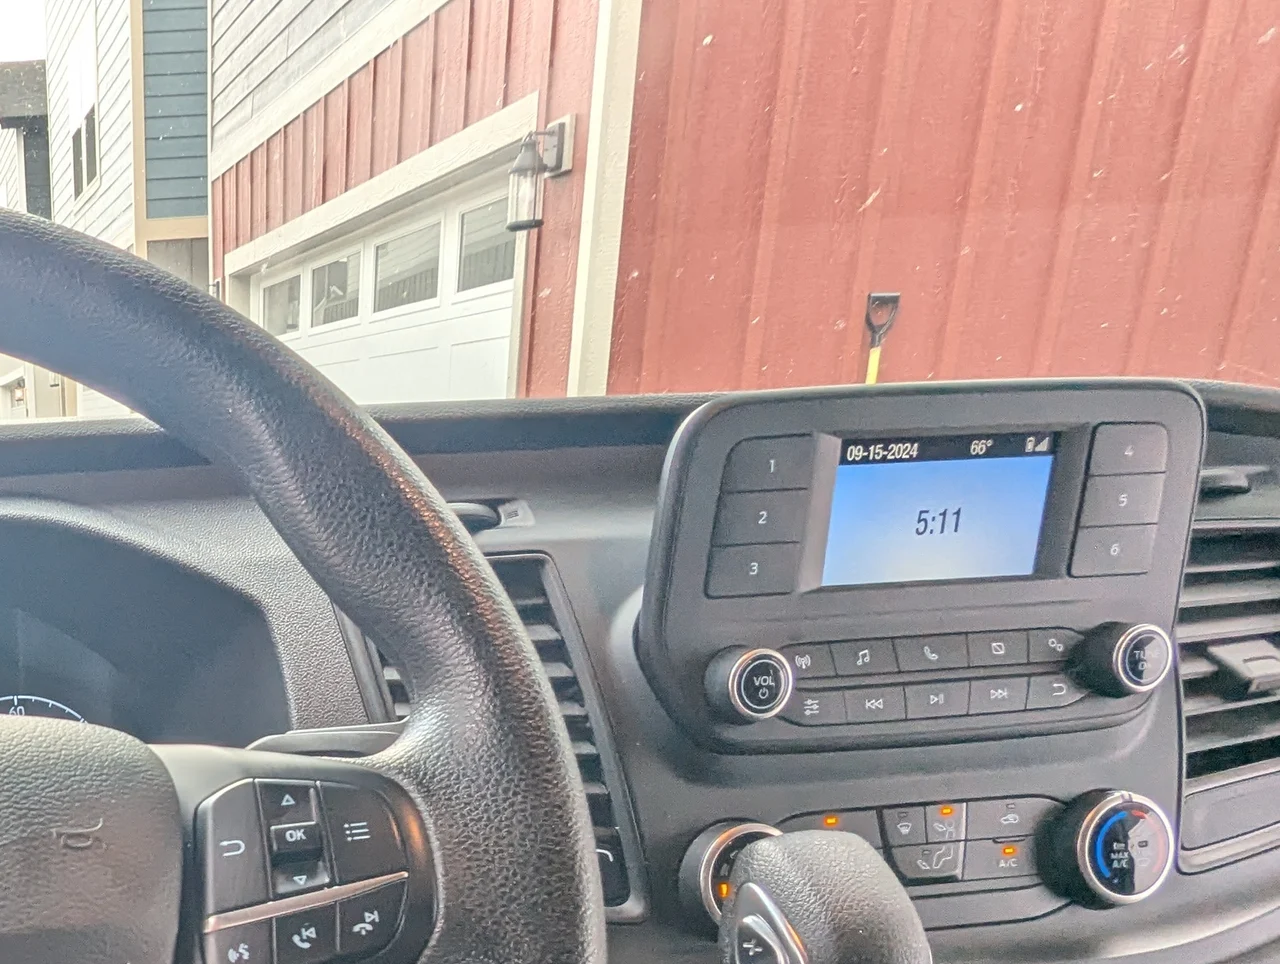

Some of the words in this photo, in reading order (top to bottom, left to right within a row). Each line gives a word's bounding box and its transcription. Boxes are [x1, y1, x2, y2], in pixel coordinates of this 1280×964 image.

[846, 443, 919, 461] 09-15-2024
[1123, 445, 1135, 457] 4
[769, 459, 776, 473] 1
[1118, 493, 1128, 507] 5
[757, 511, 768, 524] 2
[915, 507, 962, 536] 5:11
[1110, 543, 1120, 556] 6
[749, 562, 759, 575] 3
[753, 675, 775, 686] VOL
[285, 829, 307, 842] OK
[999, 858, 1018, 868] A/C
